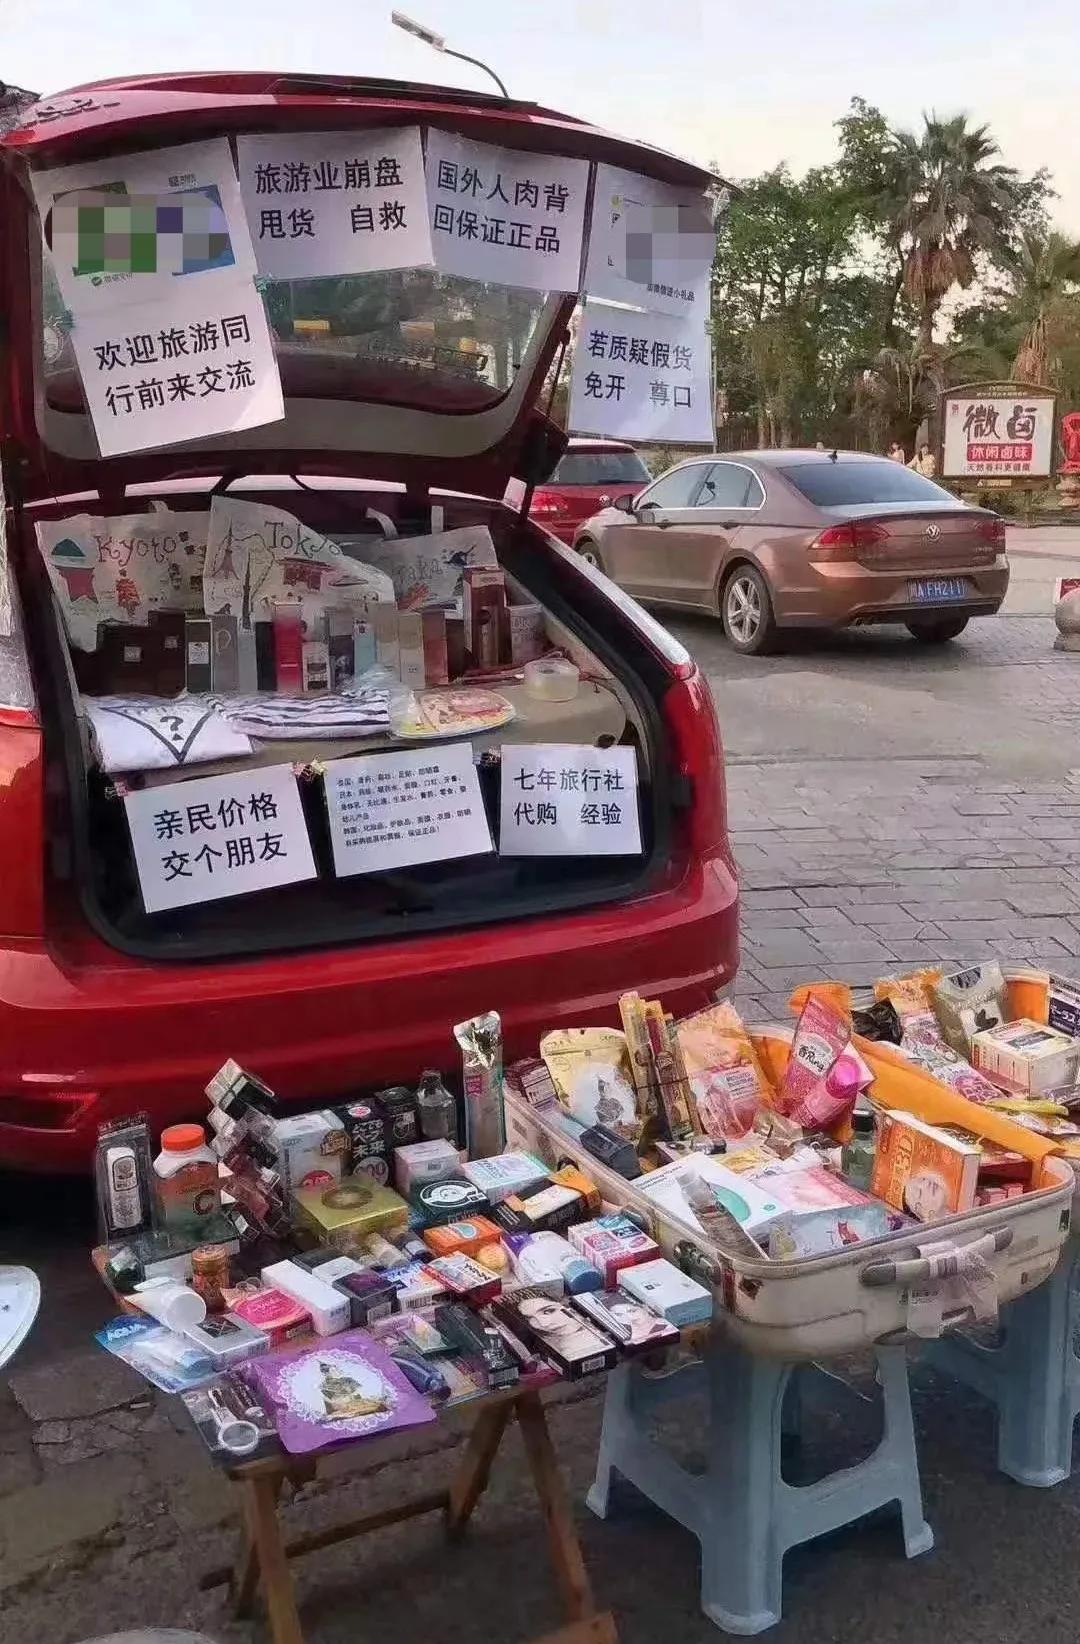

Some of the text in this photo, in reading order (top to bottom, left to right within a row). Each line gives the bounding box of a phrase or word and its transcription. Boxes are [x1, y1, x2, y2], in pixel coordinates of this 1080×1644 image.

[255, 156, 403, 195] 旅游业崩盘
[437, 159, 570, 213] 国外人肉背
[259, 200, 408, 240] 甩货 自救
[433, 204, 561, 254] 回保证正品
[94, 315, 251, 371] 欢迎旅游同
[588, 329, 693, 372] 若质疑假货
[105, 360, 256, 417] 行前来交流
[584, 371, 692, 408] 免开 尊口
[94, 536, 177, 567] Kyoto
[513, 767, 625, 793] 七年旅行社
[153, 792, 279, 841] 亲民价格
[513, 802, 623, 827] 代购 经验
[162, 830, 288, 882] 交个朋友
